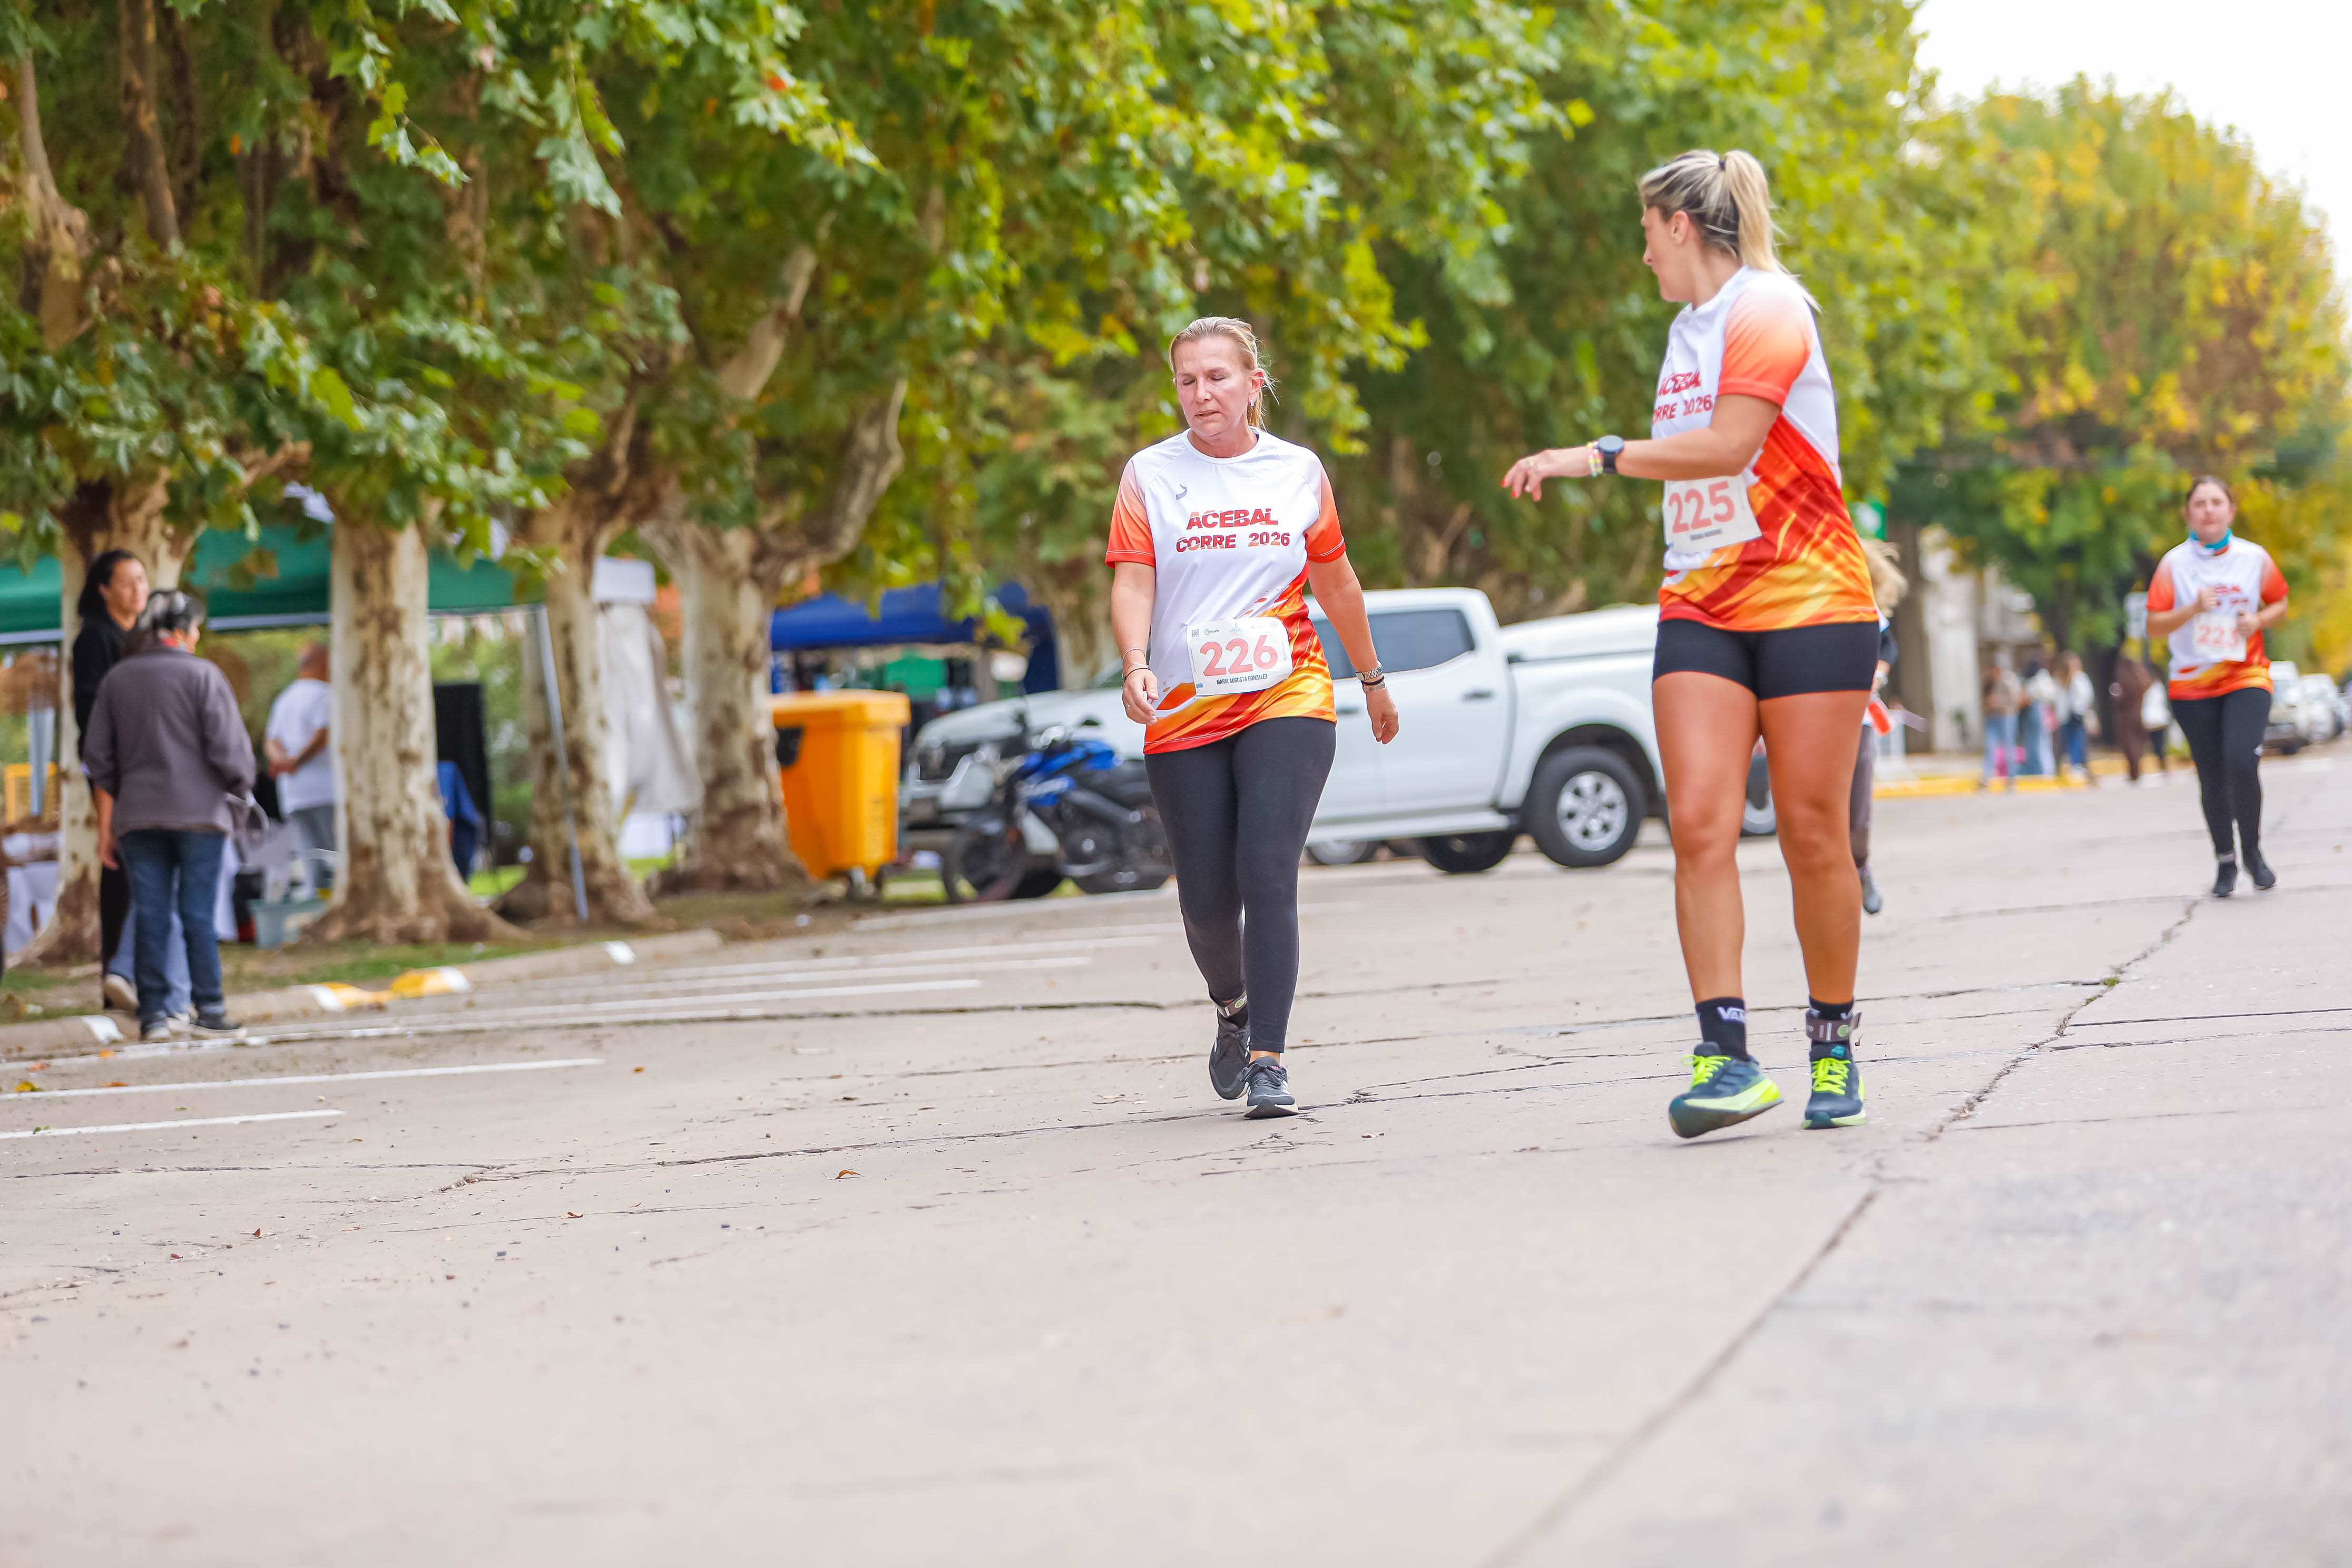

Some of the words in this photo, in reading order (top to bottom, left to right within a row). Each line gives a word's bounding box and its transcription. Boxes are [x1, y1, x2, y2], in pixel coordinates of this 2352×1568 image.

[1658, 368, 1701, 396] ACEBA
[1186, 508, 1278, 530] ACEBAL
[1669, 481, 1736, 534] 225
[1176, 534, 1237, 553] CORRE
[1248, 532, 1290, 547] 2026
[1200, 635, 1278, 677] 226
